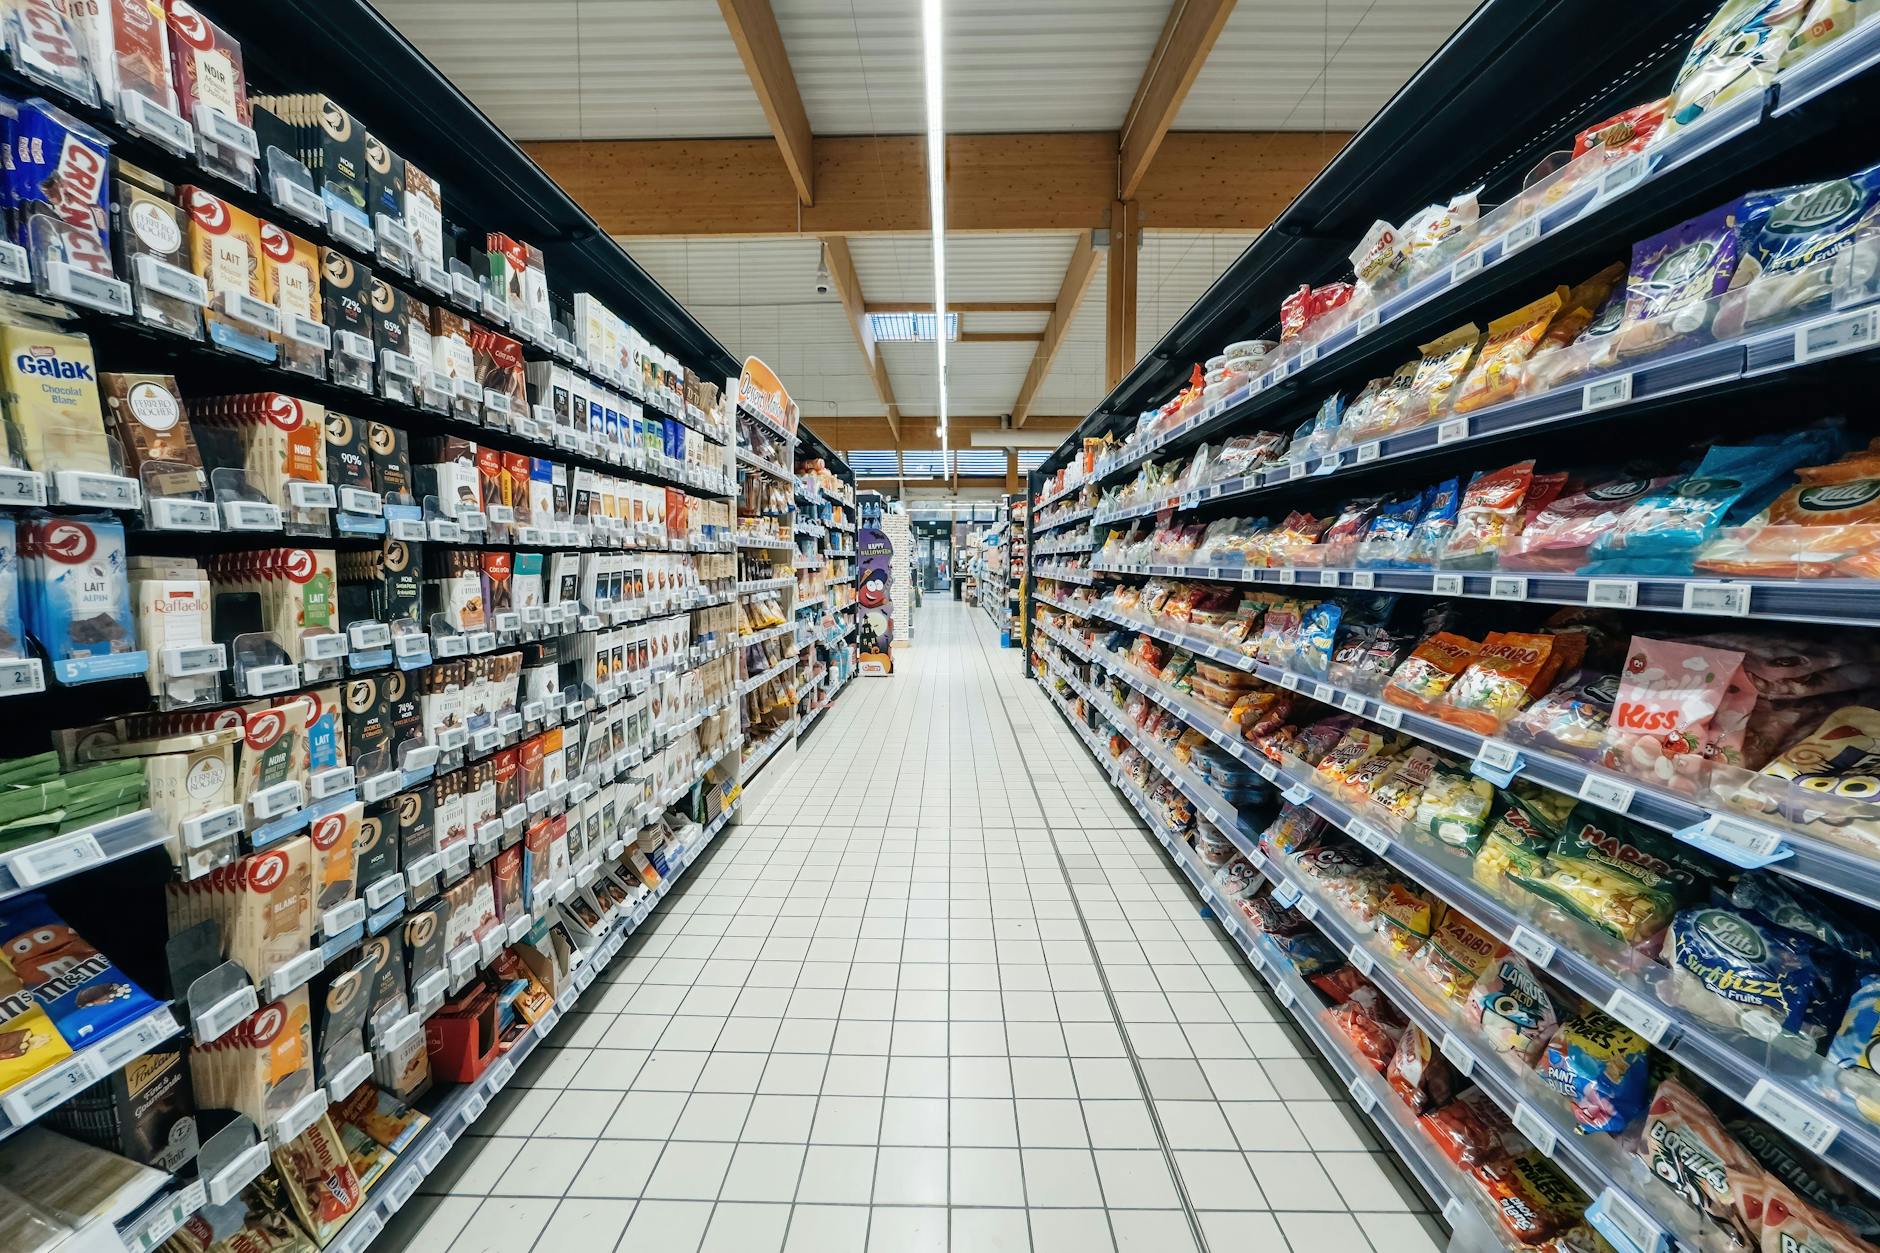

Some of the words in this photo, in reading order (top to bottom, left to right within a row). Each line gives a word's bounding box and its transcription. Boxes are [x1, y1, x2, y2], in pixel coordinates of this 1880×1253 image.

[203, 61, 227, 86] NOIR
[57, 143, 113, 278] CRUNCH
[220, 248, 242, 266] LAIT
[341, 295, 361, 314] 72%
[384, 319, 402, 336] 85%
[17, 353, 94, 382] Galak
[41, 383, 82, 397] Chocolat
[51, 394, 78, 407] Blanc
[133, 398, 174, 411] FERRERO
[137, 406, 176, 418] ROCHER
[294, 443, 312, 457] NOIR
[341, 452, 362, 466] 90%
[84, 582, 105, 592] LAIT
[83, 594, 108, 603] ALPIN
[154, 598, 209, 613] Raffaello
[308, 592, 325, 604] LAIT
[1617, 701, 1680, 731] Kiss
[315, 733, 330, 747] LAIT
[268, 752, 287, 767] NOIR
[273, 896, 298, 915] BLANC
[31, 952, 112, 1004] m&m's
[1728, 988, 1764, 1005] Fruits
[1547, 1066, 1576, 1085] PAINT
[134, 1072, 182, 1119] Gourmande
[142, 1080, 164, 1102] Fine
[305, 1121, 334, 1166] arabou
[327, 1176, 351, 1208] Daim
